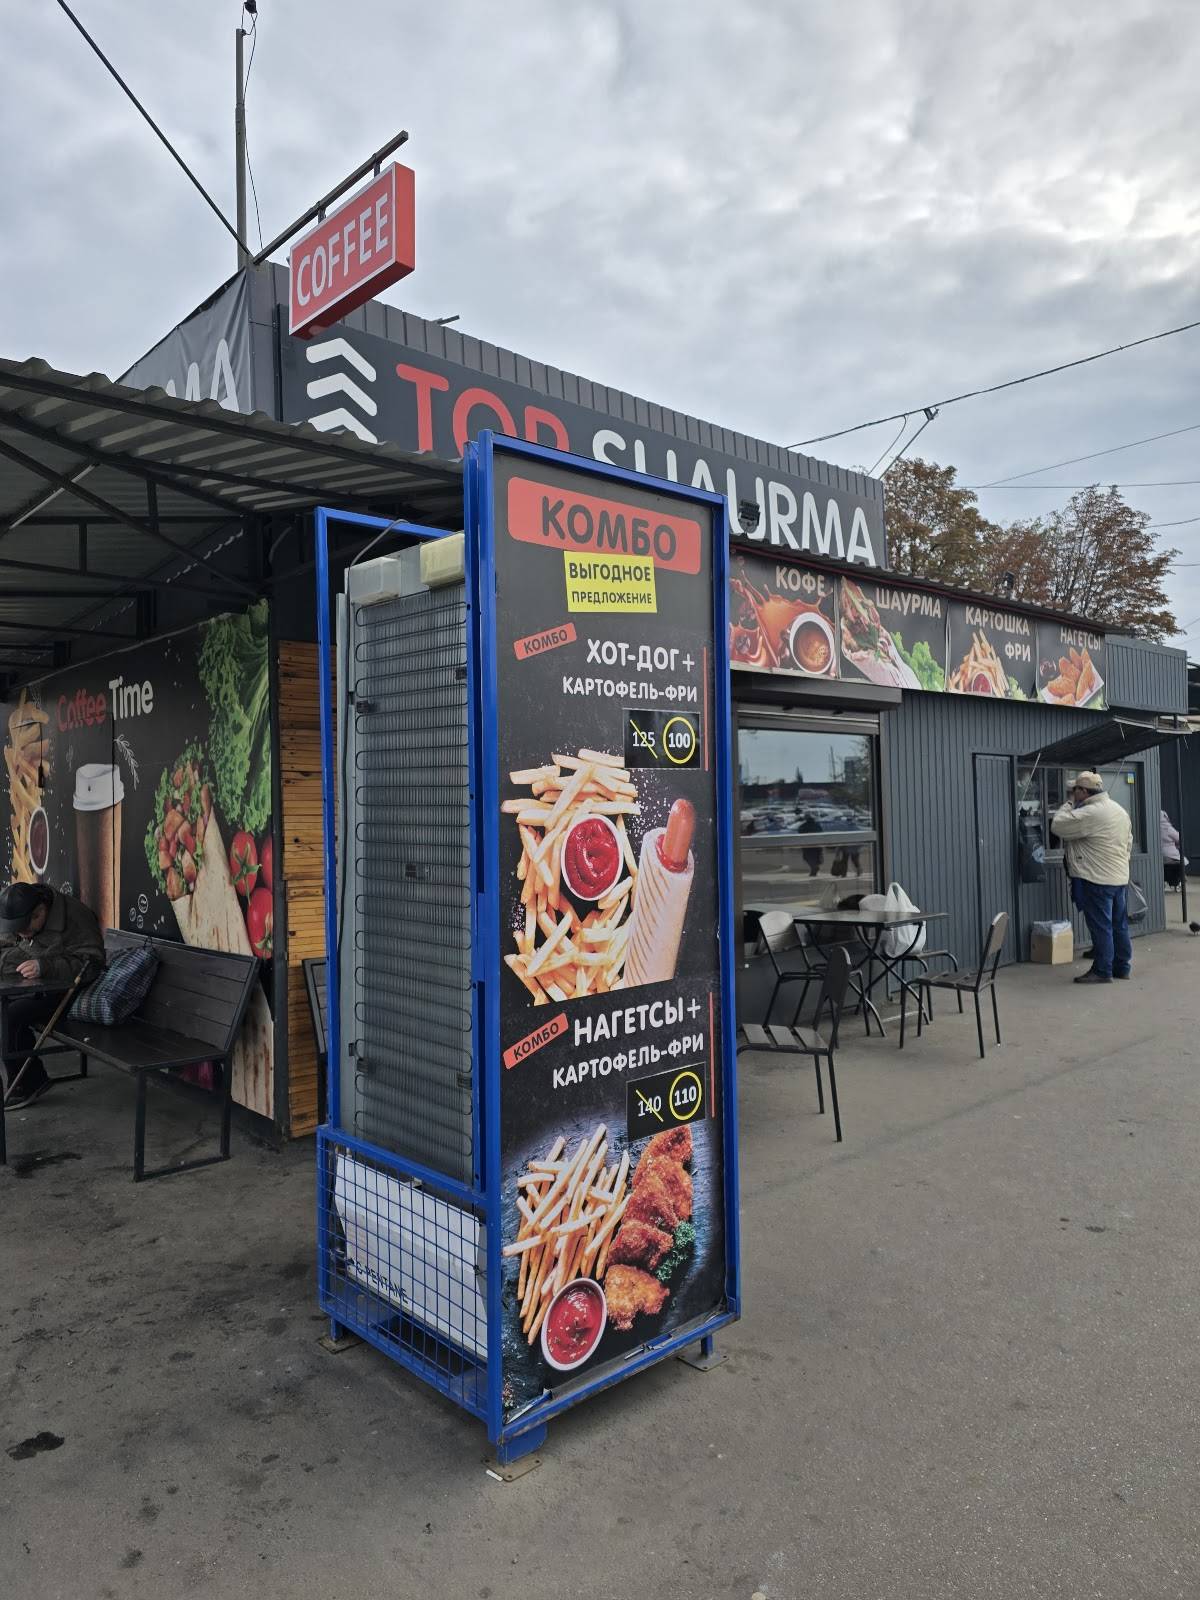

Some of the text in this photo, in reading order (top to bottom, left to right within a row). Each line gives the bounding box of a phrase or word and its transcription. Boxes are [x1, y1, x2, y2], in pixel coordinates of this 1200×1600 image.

[297, 193, 388, 306] COFFEE
[541, 495, 677, 562] КОМБО
[569, 562, 651, 583] ВЫГОДНОЕ
[775, 566, 825, 596] КОФЕ
[572, 591, 652, 605] ПРЕДЛОЖЕНИЕ
[876, 588, 942, 619] ШАУРМА
[965, 606, 1030, 637] КАРТОШКА
[523, 629, 568, 655] КОМБО
[1004, 643, 1031, 662] ФРИ
[1060, 626, 1101, 652] НАГЕТСЫ
[57, 676, 154, 732] Coffee Time
[562, 676, 698, 703] КАРТОФЕЛЬ-ФРИ
[632, 731, 691, 749] 125 100
[513, 1022, 559, 1060] КОМБО
[552, 1033, 704, 1089] КАРТОФЕЛЬ-ФРИ
[637, 1086, 697, 1117] 140 110
